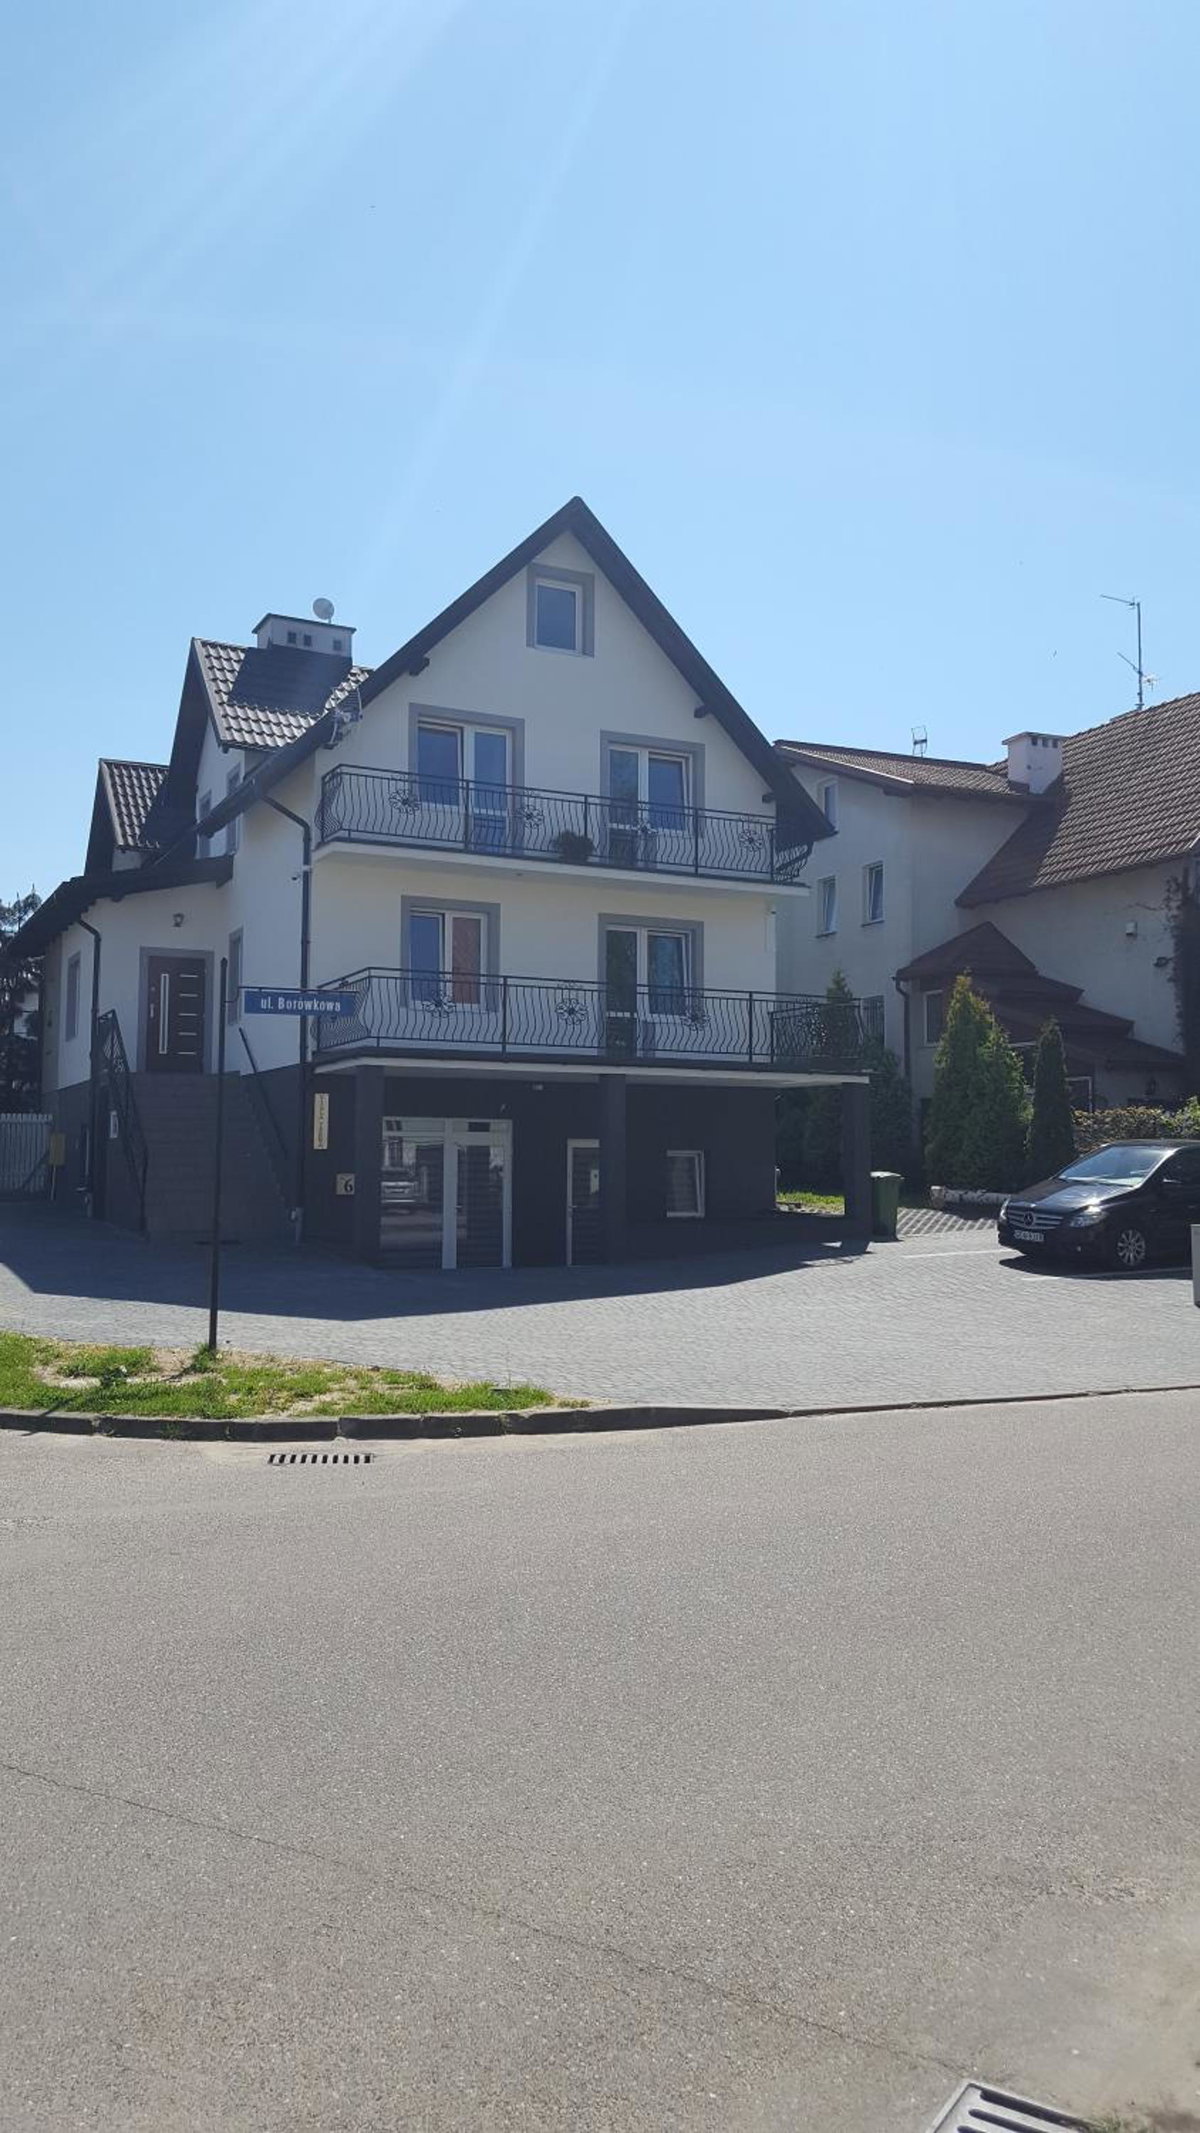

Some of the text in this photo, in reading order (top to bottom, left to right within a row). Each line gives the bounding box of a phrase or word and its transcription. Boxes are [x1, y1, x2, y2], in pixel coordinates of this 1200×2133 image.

[261, 996, 341, 1012] ul. Borówkowa
[344, 1177, 353, 1192] 6
